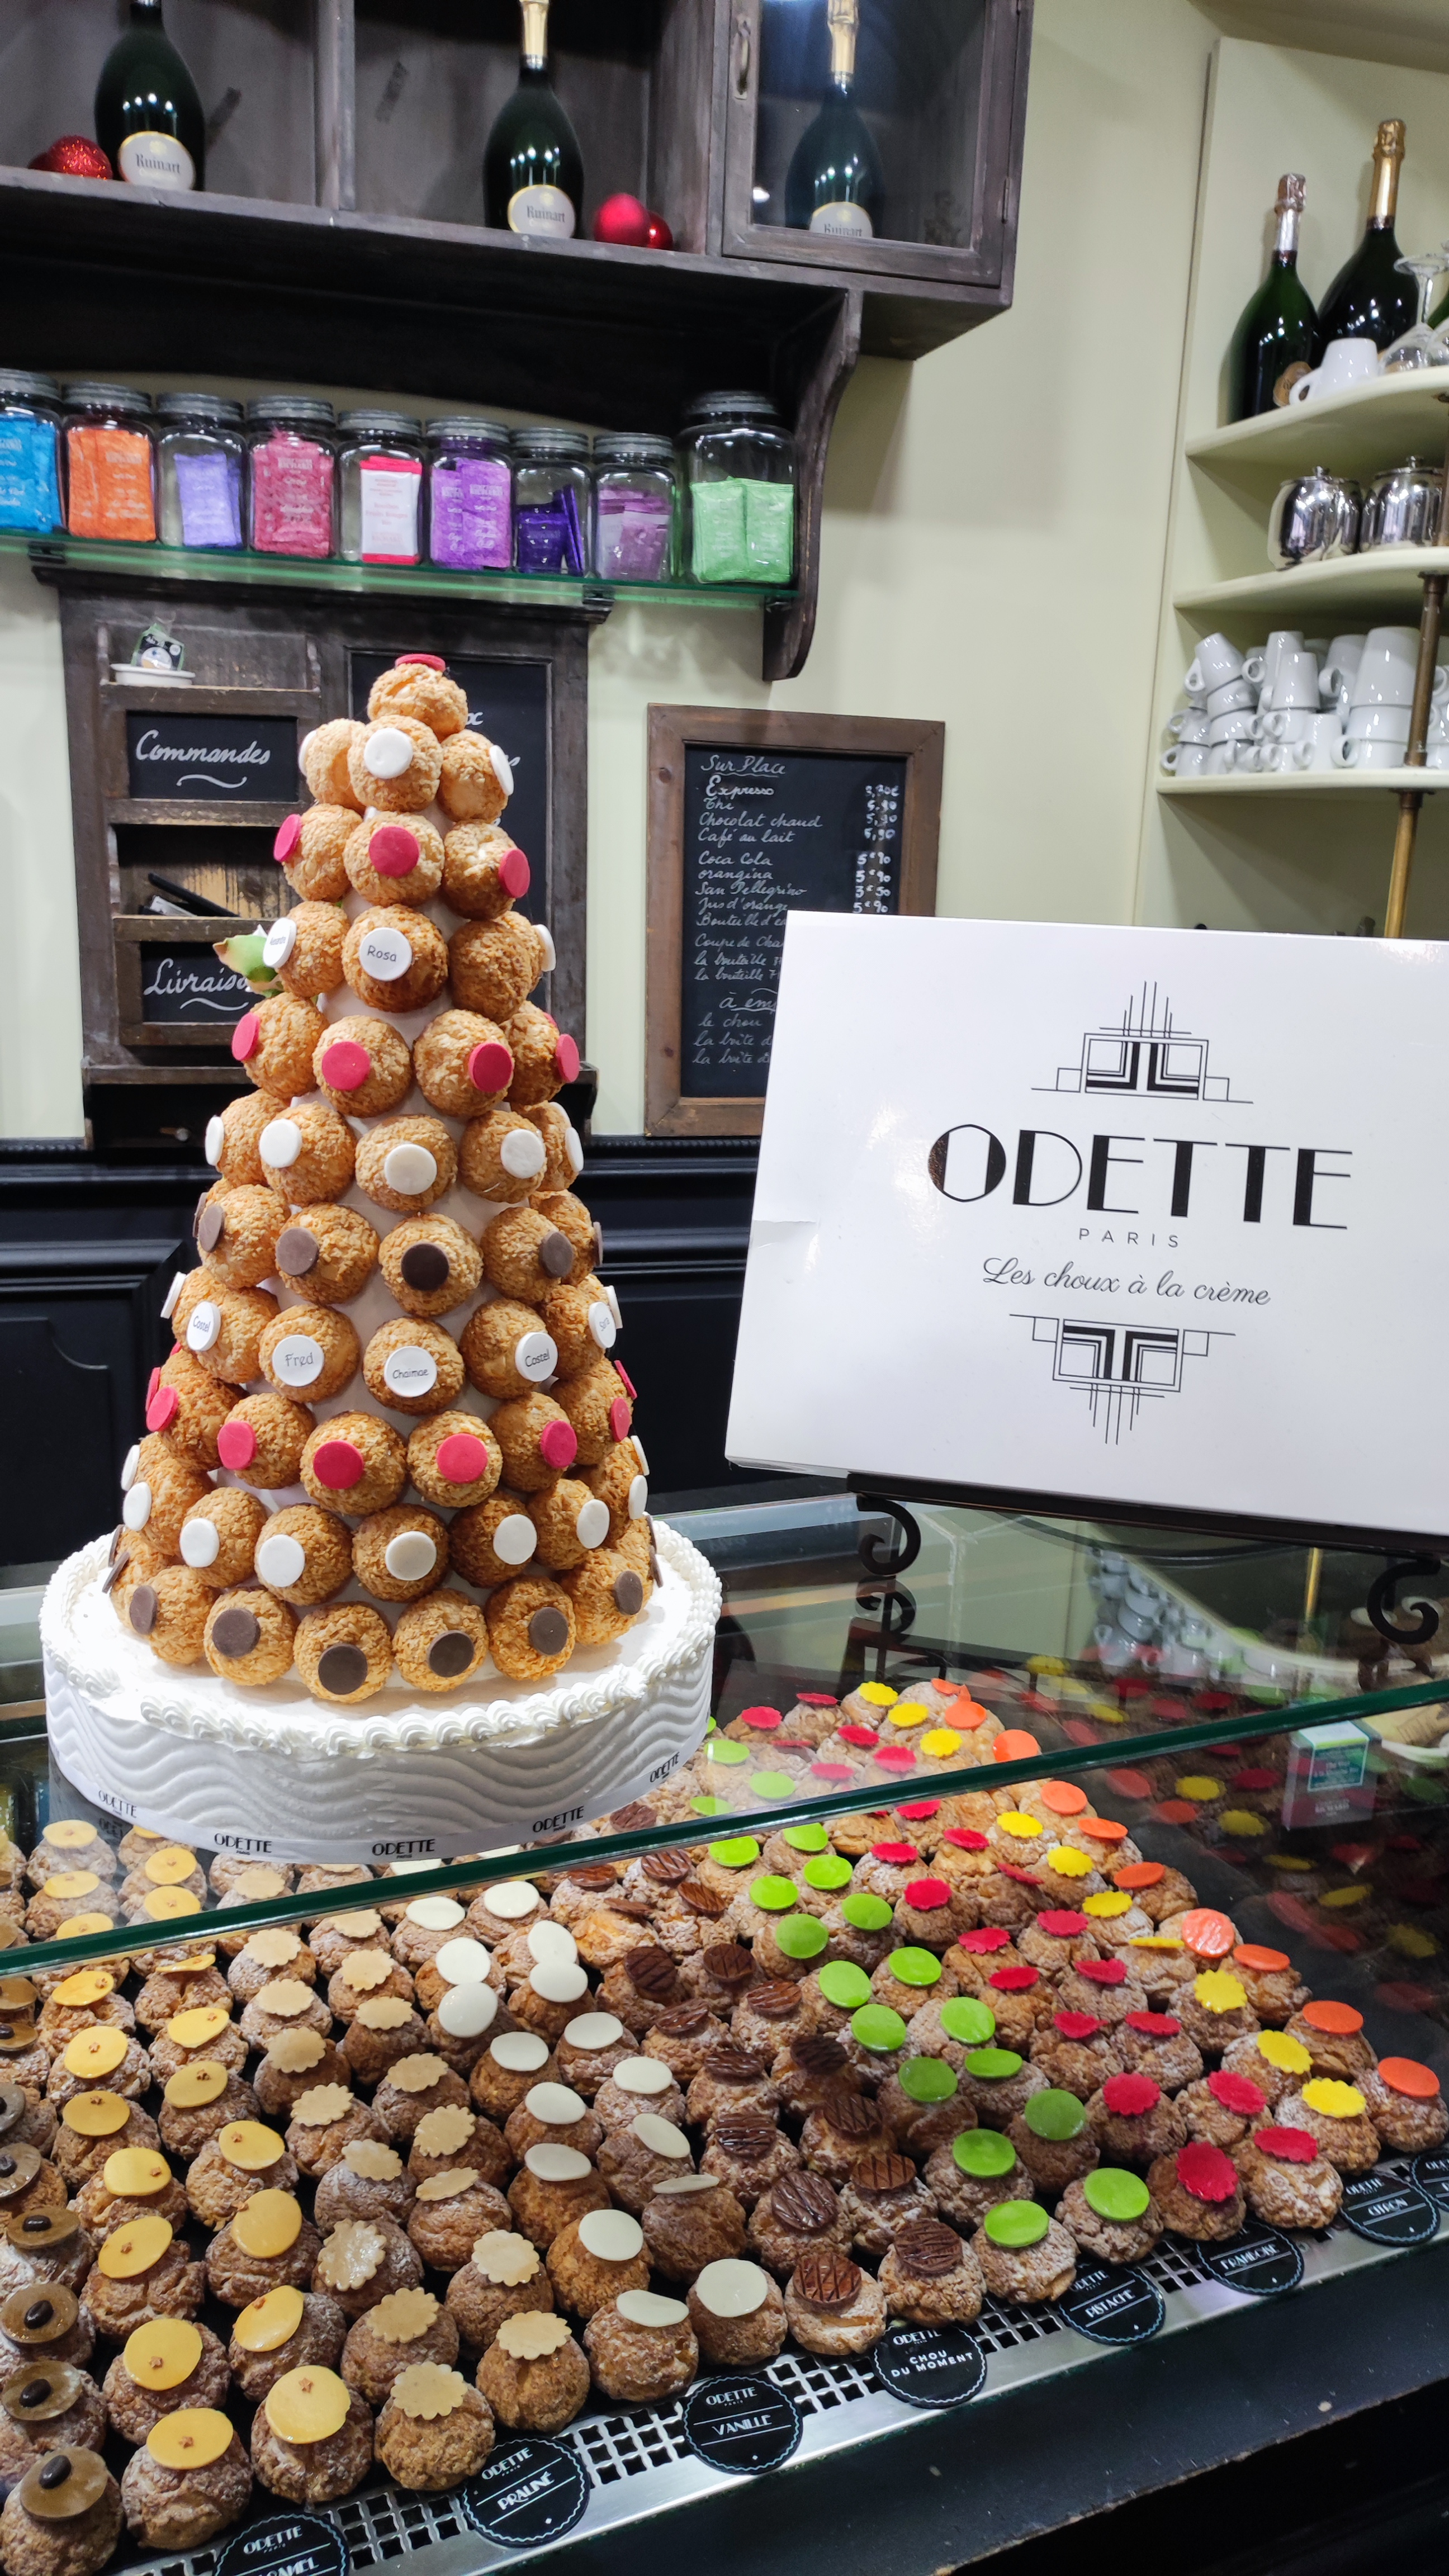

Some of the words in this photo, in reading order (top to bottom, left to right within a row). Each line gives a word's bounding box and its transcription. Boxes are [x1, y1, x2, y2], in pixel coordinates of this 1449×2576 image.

[135, 153, 180, 173] Ruinart
[527, 205, 565, 222] Ruinart
[136, 729, 271, 765] Commandes
[700, 755, 736, 771] Sur
[736, 755, 785, 774] Place
[705, 775, 774, 800] Expresso
[699, 811, 766, 827] Chocolat
[770, 813, 823, 828] chaud
[739, 834, 757, 842] au
[761, 828, 796, 843] lait
[698, 850, 735, 865] Coca
[740, 851, 774, 866] Cola
[695, 881, 726, 895] San
[730, 879, 808, 903] Pellegrino
[696, 912, 760, 926] Bouteille
[695, 933, 735, 952] Coupe
[737, 936, 751, 947] de
[367, 945, 397, 962] Rosa
[694, 950, 709, 965] la
[714, 952, 767, 965] bouteille
[143, 958, 249, 996] Livraiso
[715, 967, 764, 981] bouteille
[723, 1013, 763, 1027] chou
[693, 1030, 714, 1046] la
[692, 1048, 711, 1064] la
[927, 1124, 1353, 1230] ODETTE
[1078, 1228, 1179, 1248] PARIS
[982, 1257, 1036, 1285] Les
[1043, 1261, 1120, 1294] choux
[1128, 1275, 1148, 1295] à
[1156, 1270, 1185, 1298] la
[1193, 1281, 1272, 1306] crème
[285, 1351, 314, 1367] Fred
[525, 1348, 550, 1367] Costel
[650, 1751, 680, 1783] ODETTE
[98, 1790, 137, 1818] ODETTE
[532, 1805, 584, 1832] ODETTE
[214, 1833, 272, 1853] ODETTE
[371, 1838, 435, 1856] ODETTE
[1085, 2289, 1136, 2318] PISTACHE
[891, 2366, 910, 2377] DU
[916, 2352, 973, 2372] MOMENT
[909, 2350, 947, 2364] CHOU
[705, 2386, 757, 2405] ODETTE
[711, 2414, 773, 2436] VANILLE
[481, 2447, 533, 2480] ODETTE
[497, 2471, 555, 2510] PRALINÉ
[243, 2525, 303, 2555] ODETTE
